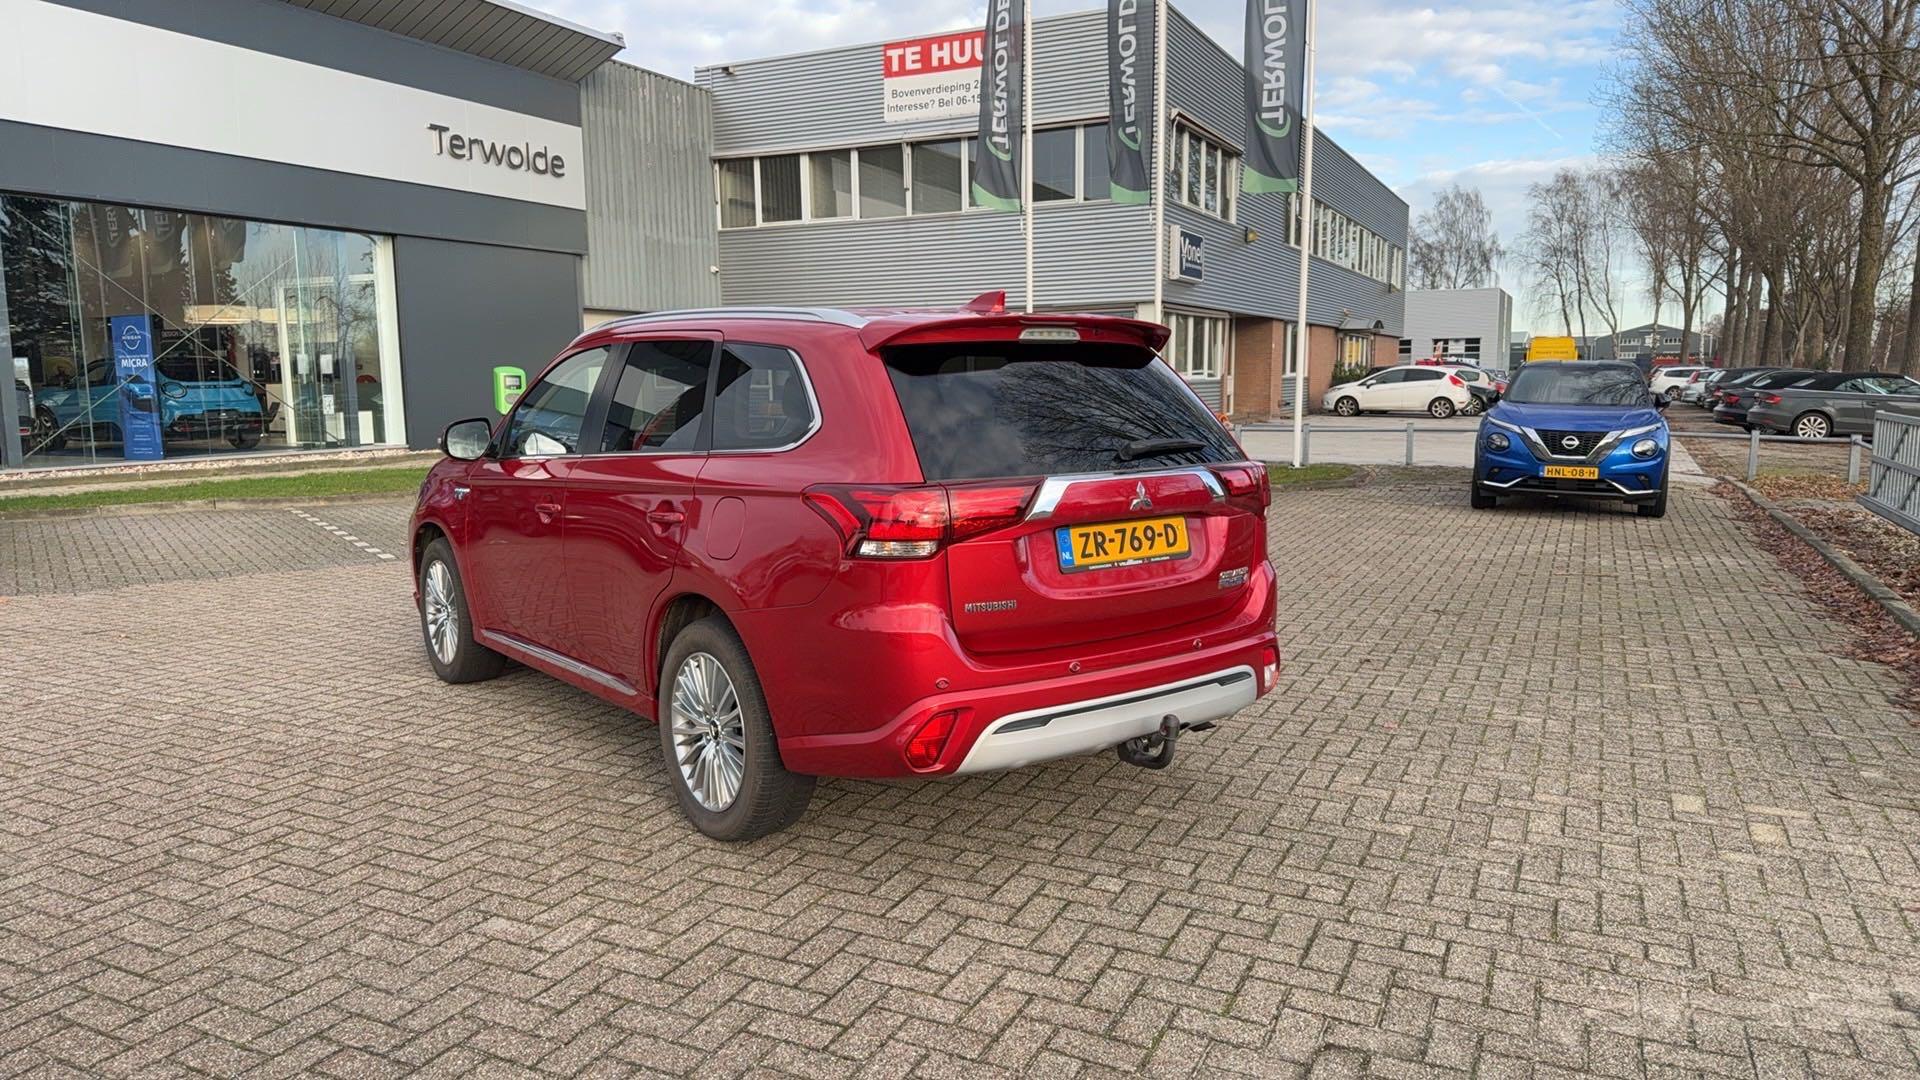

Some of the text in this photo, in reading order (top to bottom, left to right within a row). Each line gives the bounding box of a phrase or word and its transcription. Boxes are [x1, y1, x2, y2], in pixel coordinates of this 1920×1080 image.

[886, 45, 922, 72] TE
[891, 81, 971, 99] Bovenverdieping
[887, 99, 935, 113] Interesse?
[938, 97, 954, 108] Bel
[427, 123, 565, 178] Terwolde
[121, 358, 148, 368] MICRA
[1546, 467, 1596, 478] HNL-08-H
[1078, 523, 1178, 559] ZR-769-D
[1062, 551, 1073, 561] NL
[965, 600, 1017, 613] MITSUBISHI
